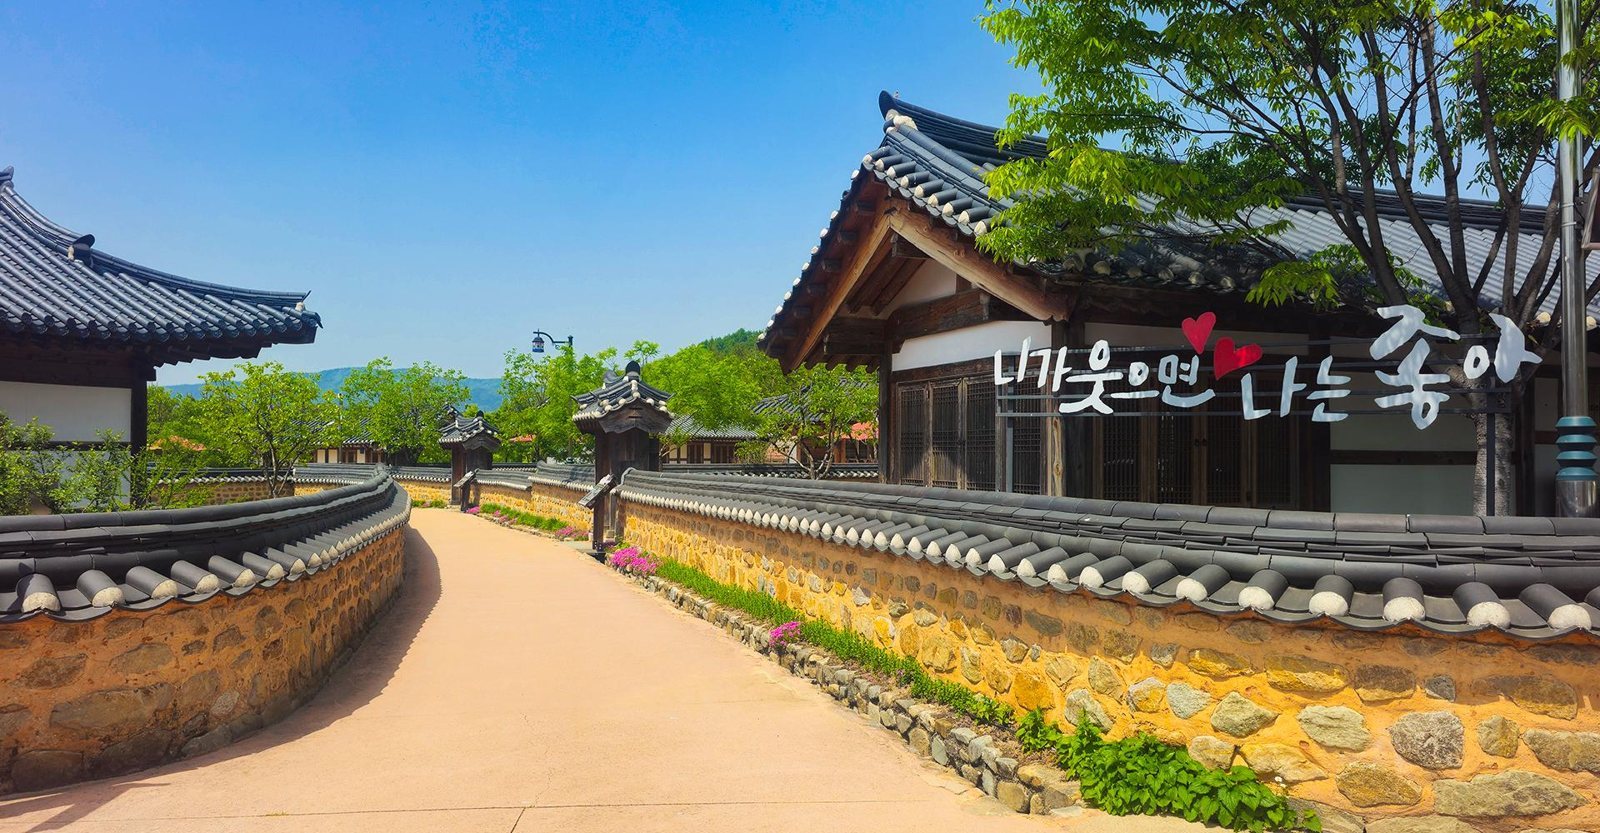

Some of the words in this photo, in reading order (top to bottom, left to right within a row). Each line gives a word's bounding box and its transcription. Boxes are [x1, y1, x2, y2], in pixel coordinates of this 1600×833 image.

[994, 336, 1072, 392] 니가
[1058, 340, 1216, 414] 웃으면
[1241, 355, 1351, 422] 나는
[1369, 304, 1543, 430] 좋아
